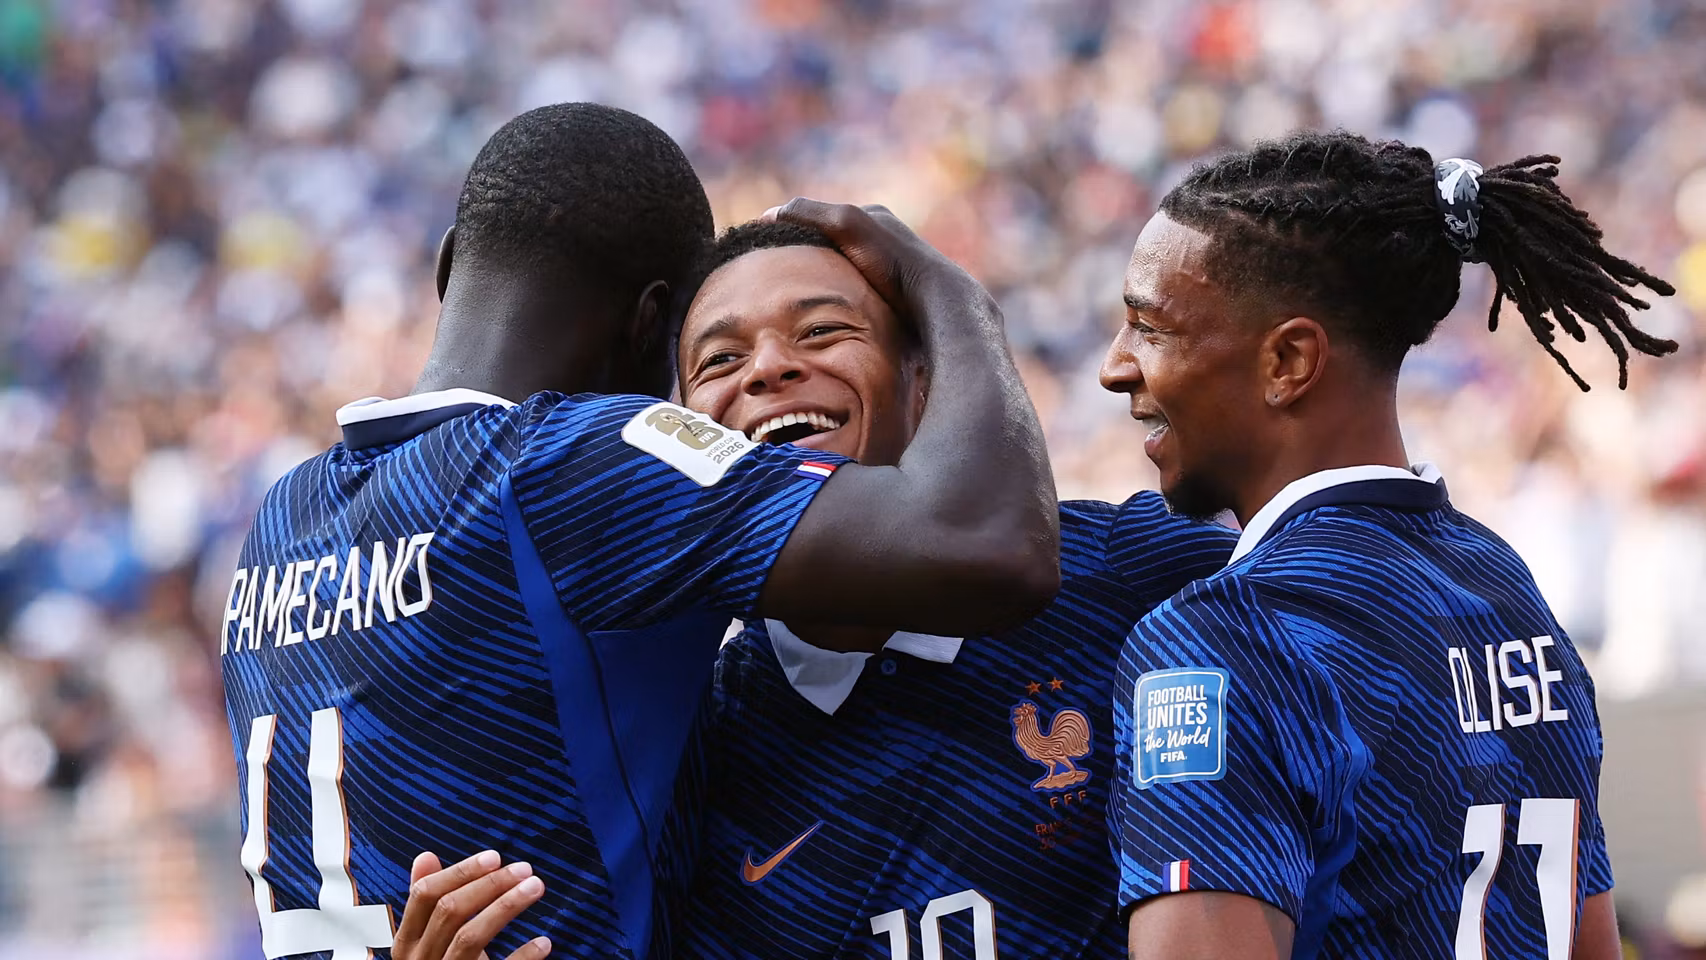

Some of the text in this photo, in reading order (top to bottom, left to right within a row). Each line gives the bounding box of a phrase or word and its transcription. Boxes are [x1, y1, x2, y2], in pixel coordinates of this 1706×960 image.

[705, 436, 735, 458] WORLD CUP
[713, 441, 745, 464] 2026
[221, 531, 435, 656] PAMECANO
[1147, 684, 1208, 707] FOOTBALL
[1448, 635, 1569, 733] OLISE
[1147, 702, 1208, 730] UNITES
[1144, 725, 1211, 753] the World
[1160, 750, 1187, 763] FIFA
[240, 707, 397, 960] 4
[1455, 798, 1580, 960] 11
[869, 888, 999, 960] 10
